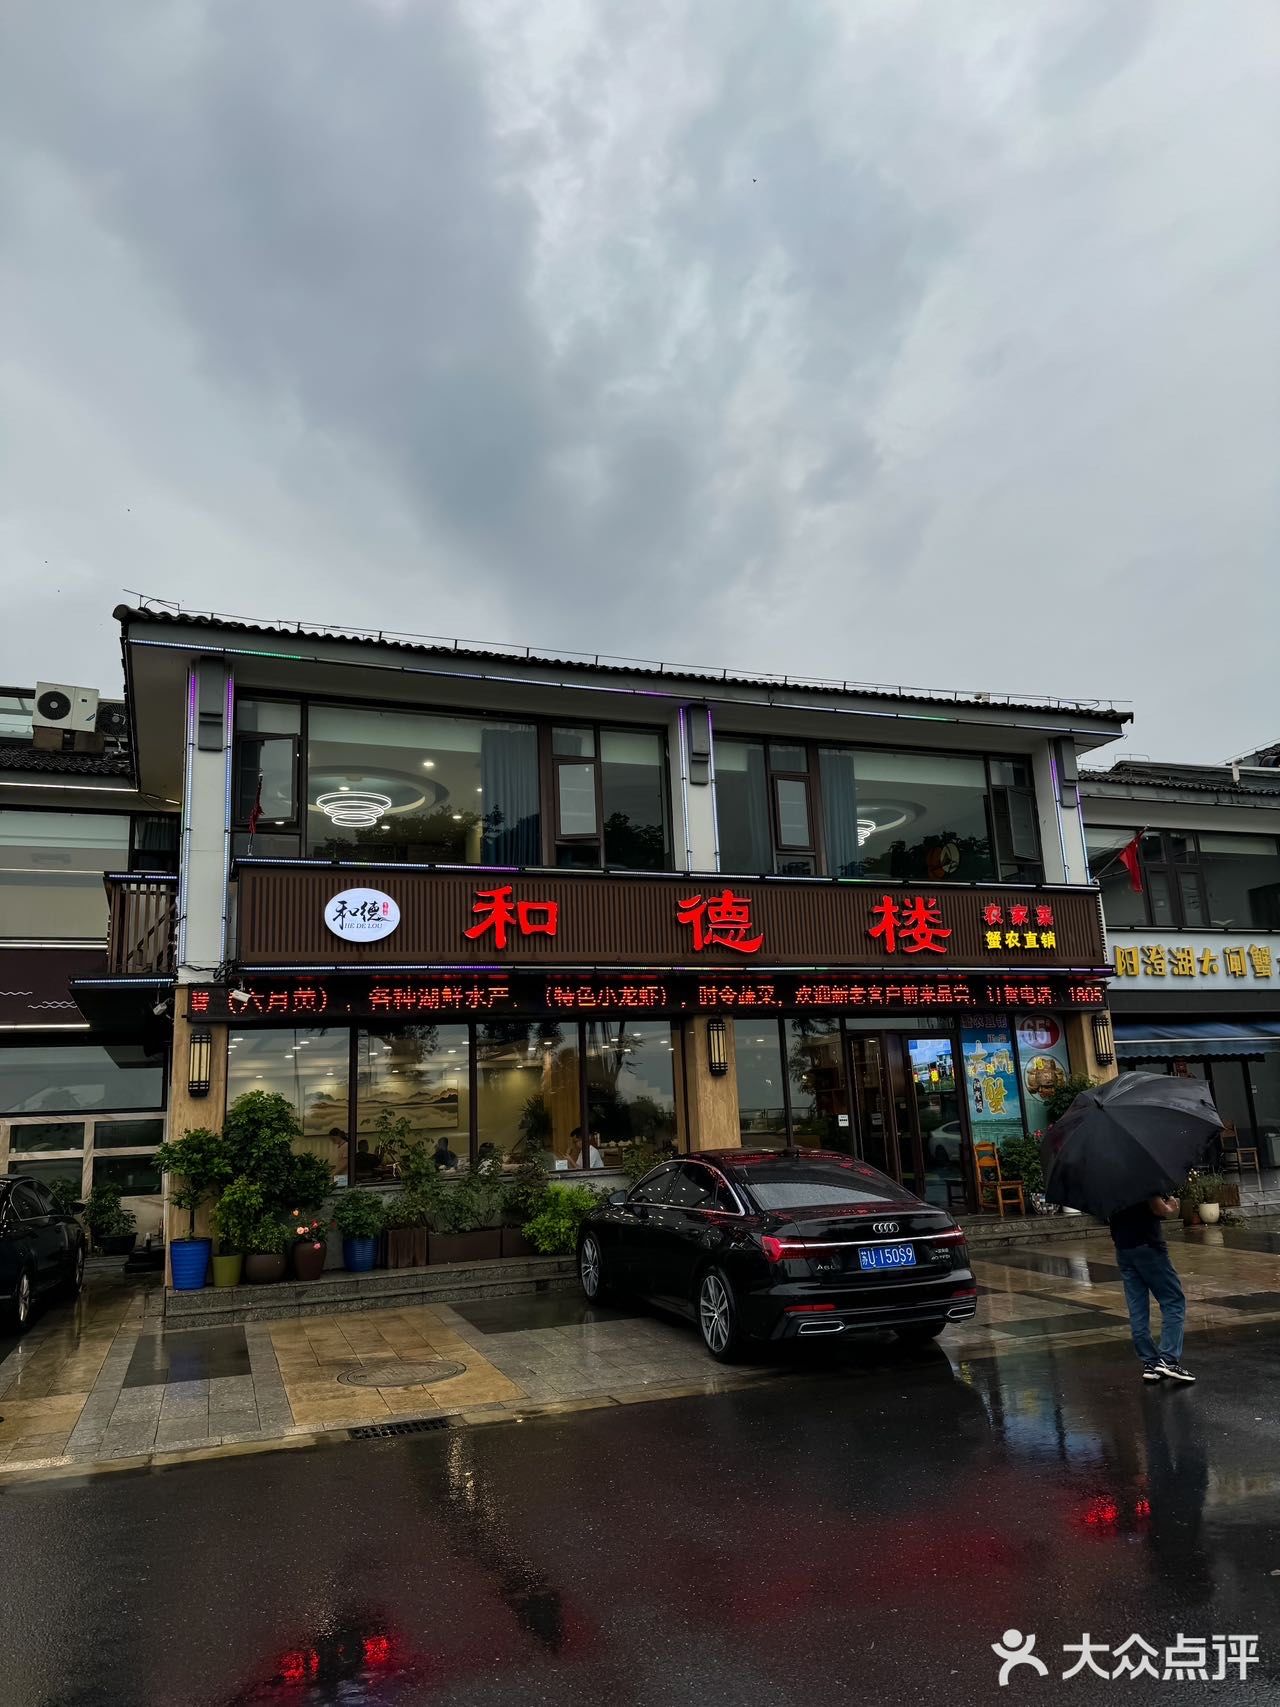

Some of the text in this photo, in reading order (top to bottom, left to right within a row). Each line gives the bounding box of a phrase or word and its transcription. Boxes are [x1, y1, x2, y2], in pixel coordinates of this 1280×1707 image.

[332, 900, 394, 930] 和德
[983, 903, 1054, 927] 农家菜
[985, 929, 1057, 950] 蟹农直销
[1113, 943, 1273, 978] 阳澄湖大闸蟹
